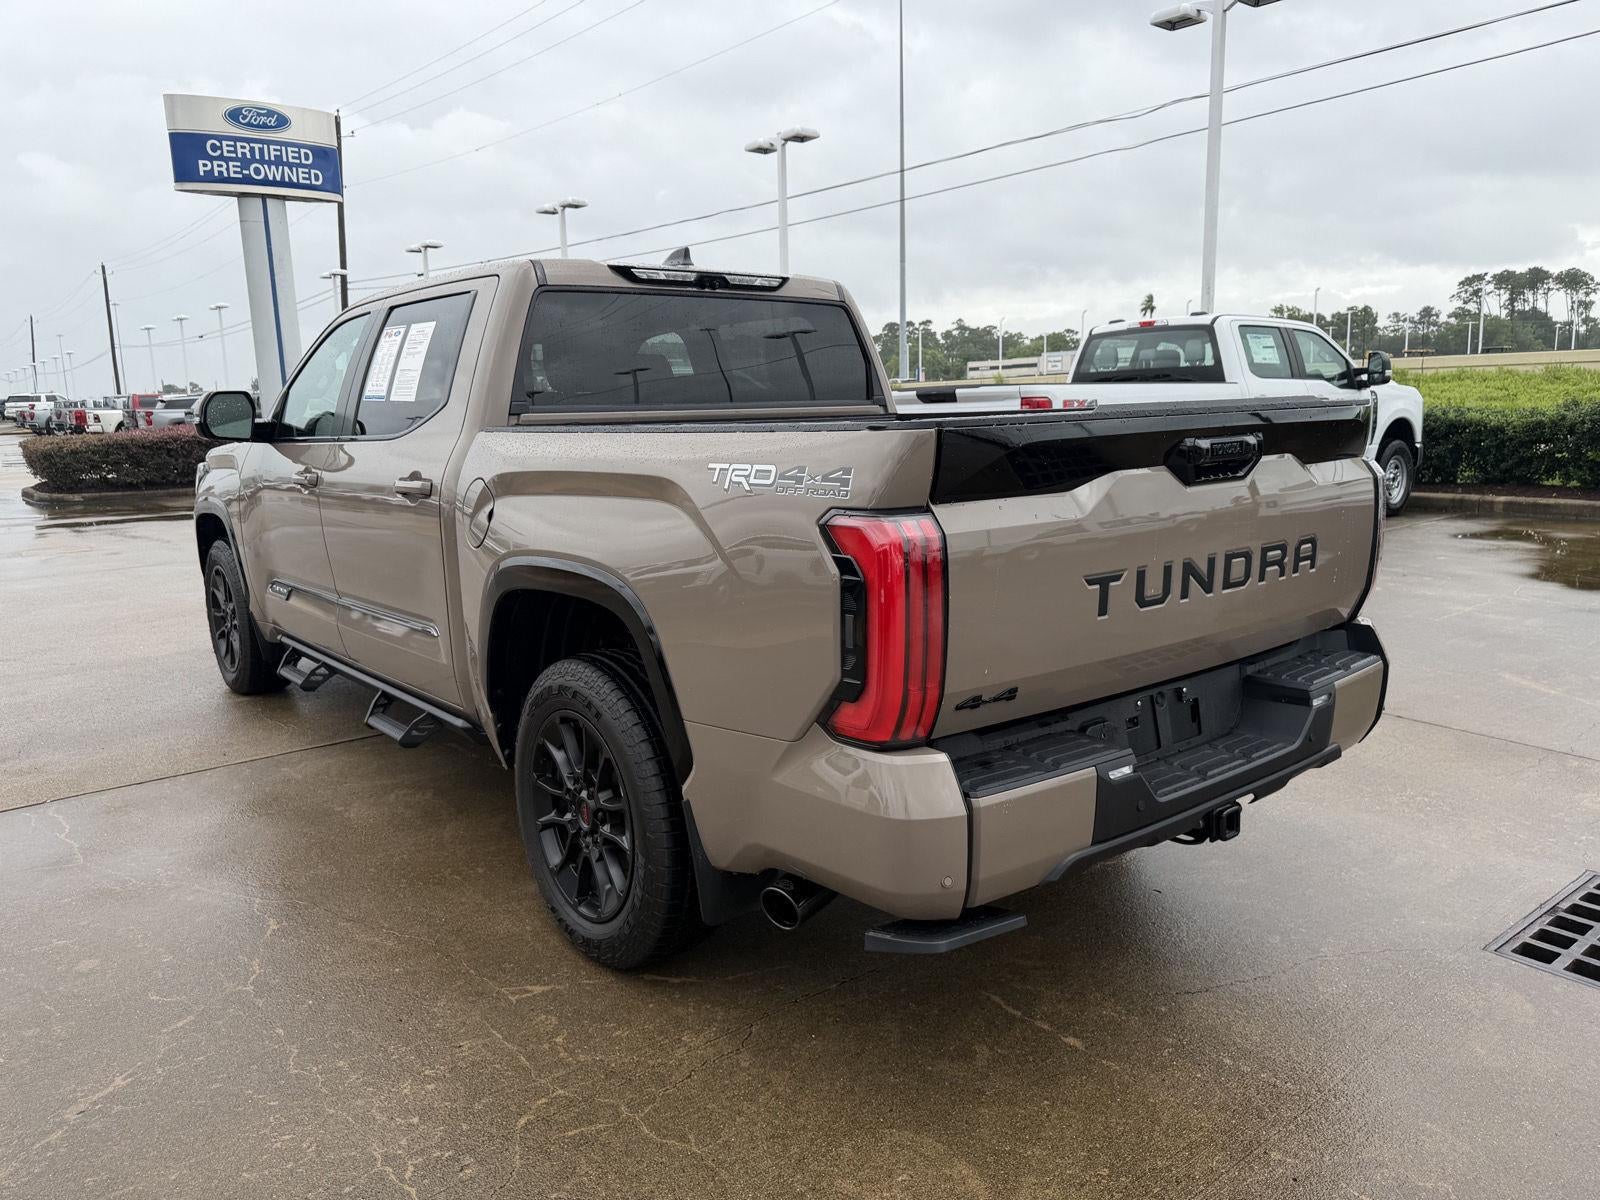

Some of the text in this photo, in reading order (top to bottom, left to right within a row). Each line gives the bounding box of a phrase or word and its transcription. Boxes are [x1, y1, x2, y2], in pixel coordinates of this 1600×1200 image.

[239, 106, 278, 127] Ford
[205, 139, 313, 165] CERTIFIED
[198, 159, 323, 186] PRE-OWNED
[707, 462, 777, 496] TRD
[775, 486, 851, 499] OFF ROAD
[1082, 533, 1318, 620] TUNDRA
